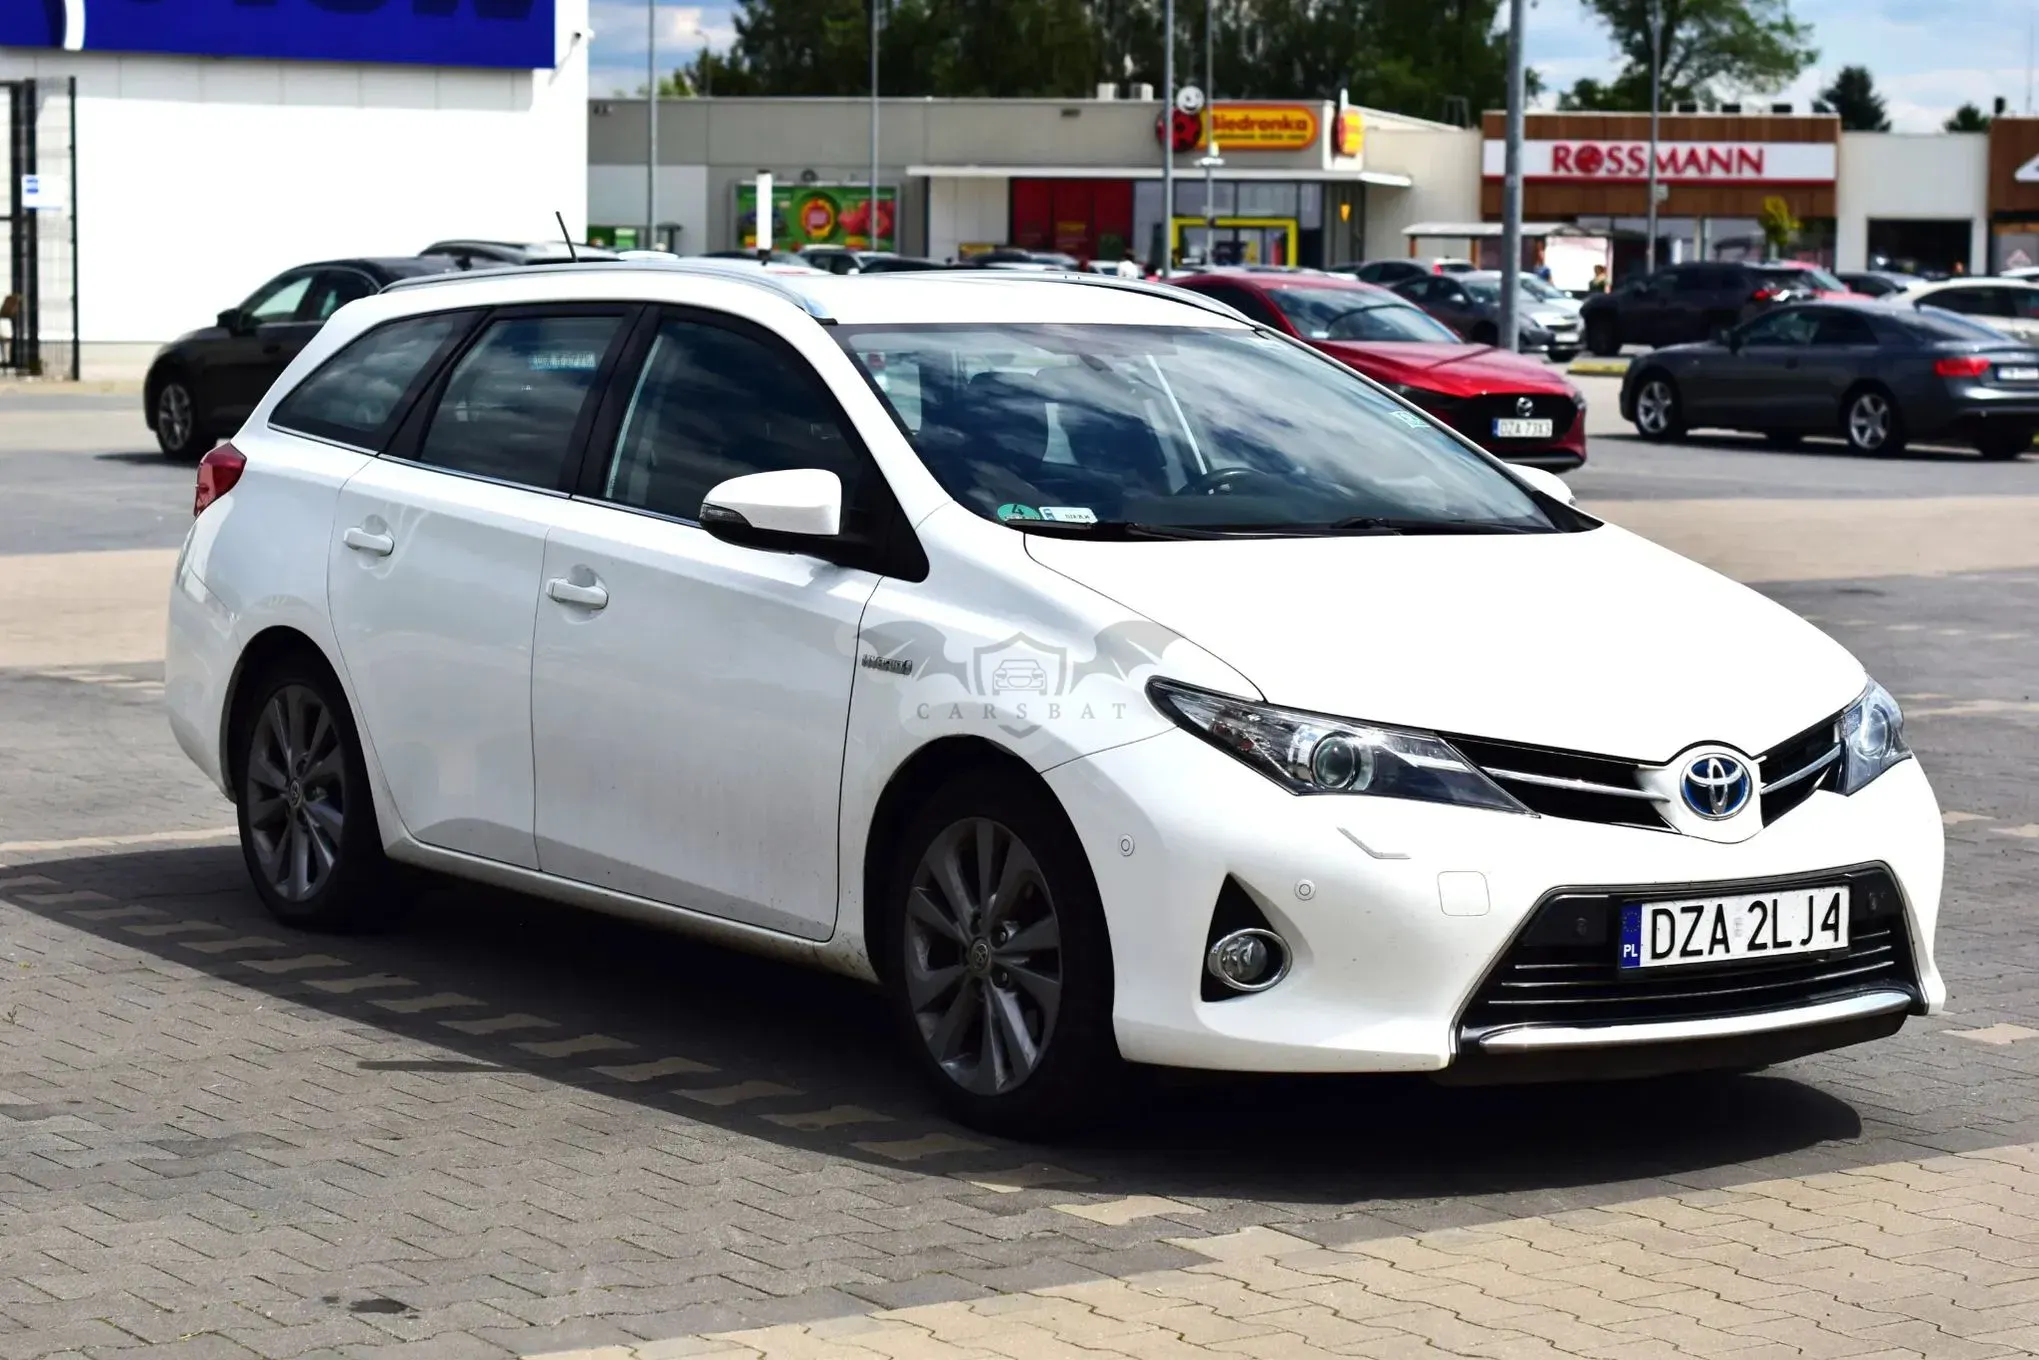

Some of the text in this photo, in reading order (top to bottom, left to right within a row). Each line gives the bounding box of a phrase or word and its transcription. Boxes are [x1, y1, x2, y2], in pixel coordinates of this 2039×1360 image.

[1552, 145, 1765, 175] ROSSMANN
[1650, 891, 1840, 960] DZA 2LJ4
[1623, 943, 1638, 958] PL
